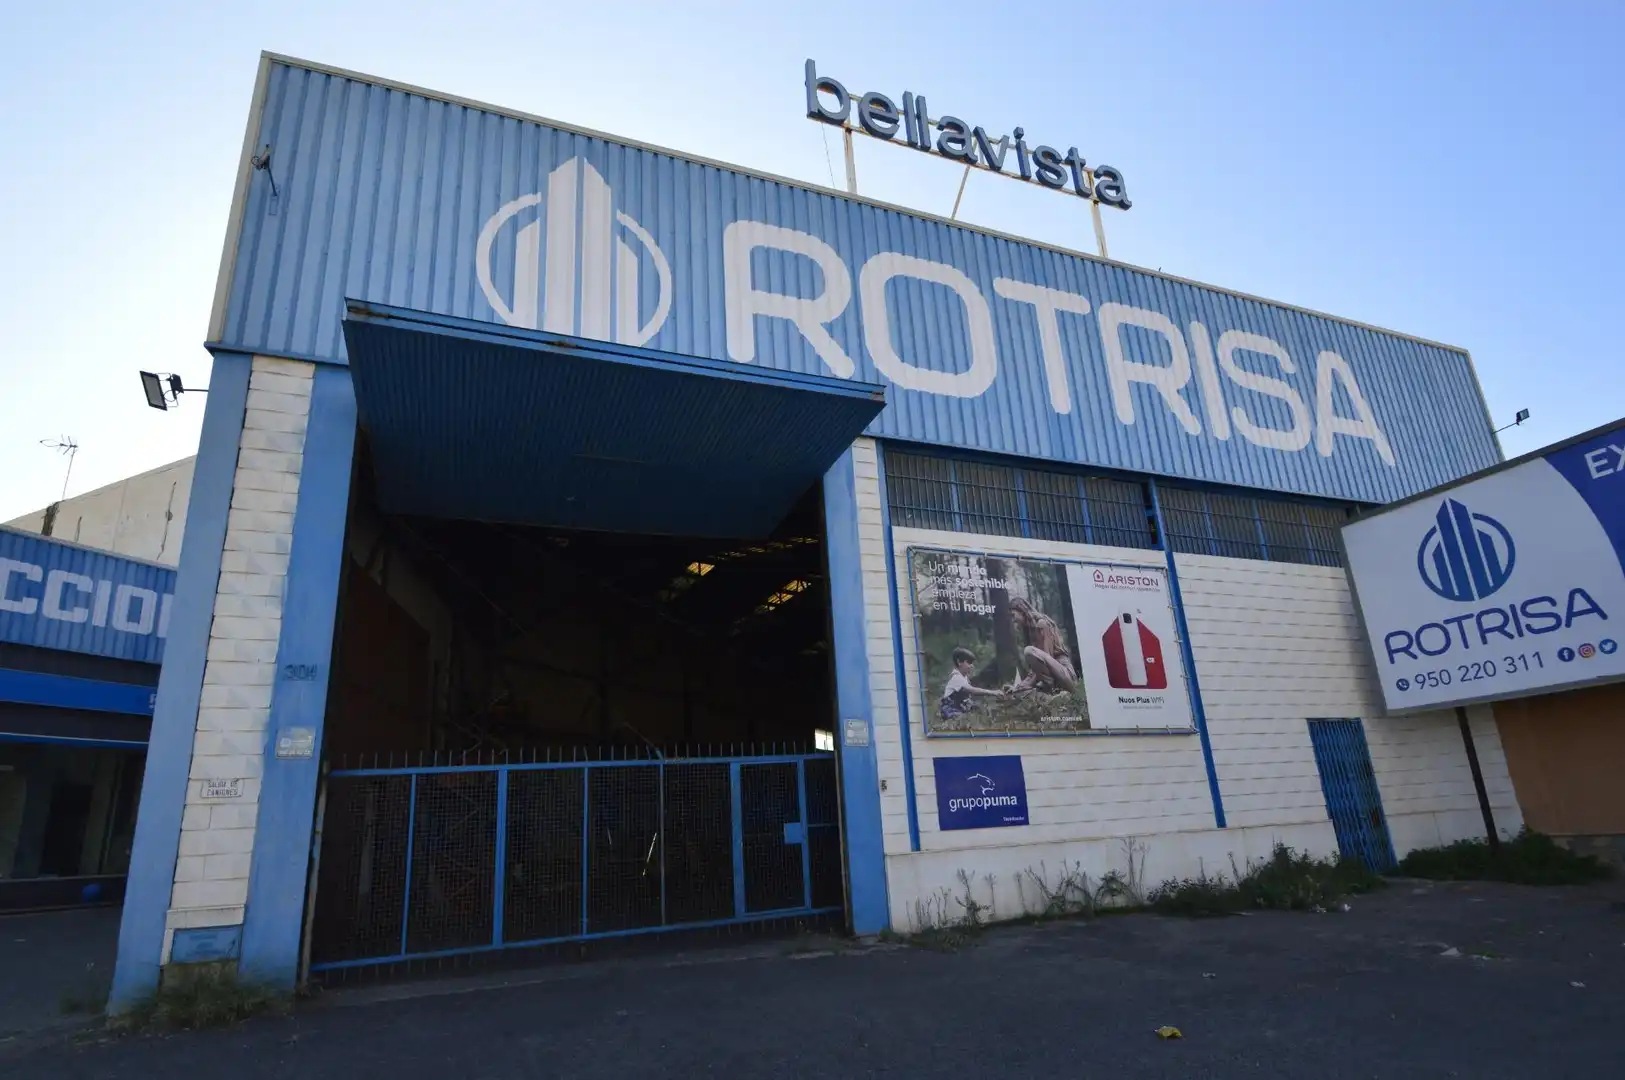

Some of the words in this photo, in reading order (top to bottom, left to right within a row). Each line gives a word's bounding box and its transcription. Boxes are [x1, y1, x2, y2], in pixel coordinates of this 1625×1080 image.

[804, 58, 1132, 211] bellavista
[723, 219, 1395, 467] ROTRISA
[928, 560, 944, 573] Un
[1107, 575, 1159, 587] ARISTON
[933, 601, 948, 611] en
[950, 600, 961, 611] tu
[963, 601, 996, 615] hogar
[1384, 587, 1608, 664] ROTRISA
[1414, 668, 1452, 690] 950
[1457, 660, 1497, 682] 220
[1503, 651, 1544, 674] 311
[1118, 696, 1136, 704] Nuos
[948, 795, 1018, 813] grupopuma
